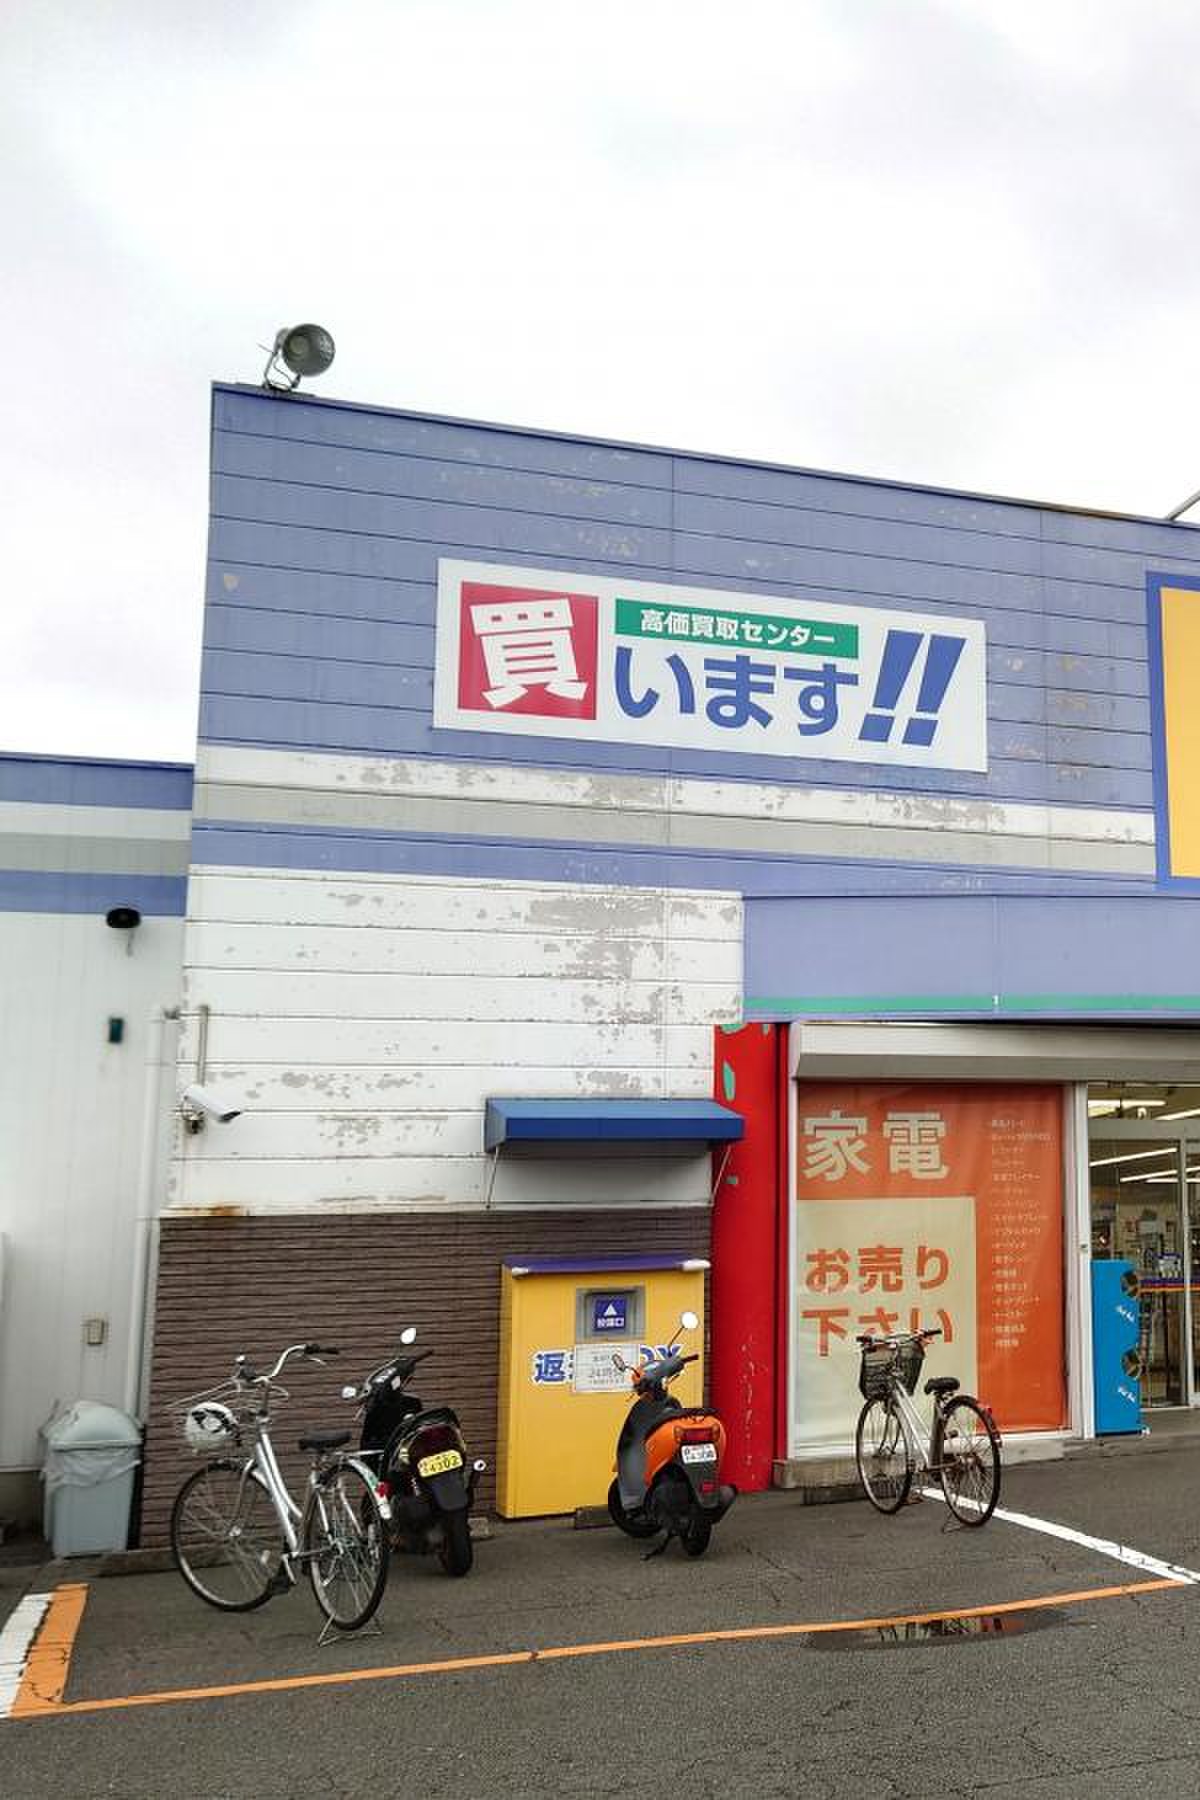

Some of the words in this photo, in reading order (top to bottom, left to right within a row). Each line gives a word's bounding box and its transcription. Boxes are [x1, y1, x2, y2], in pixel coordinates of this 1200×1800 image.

[640, 608, 836, 647] 高価買取センター
[803, 1109, 949, 1181] 家電
[805, 1244, 950, 1294] お売り
